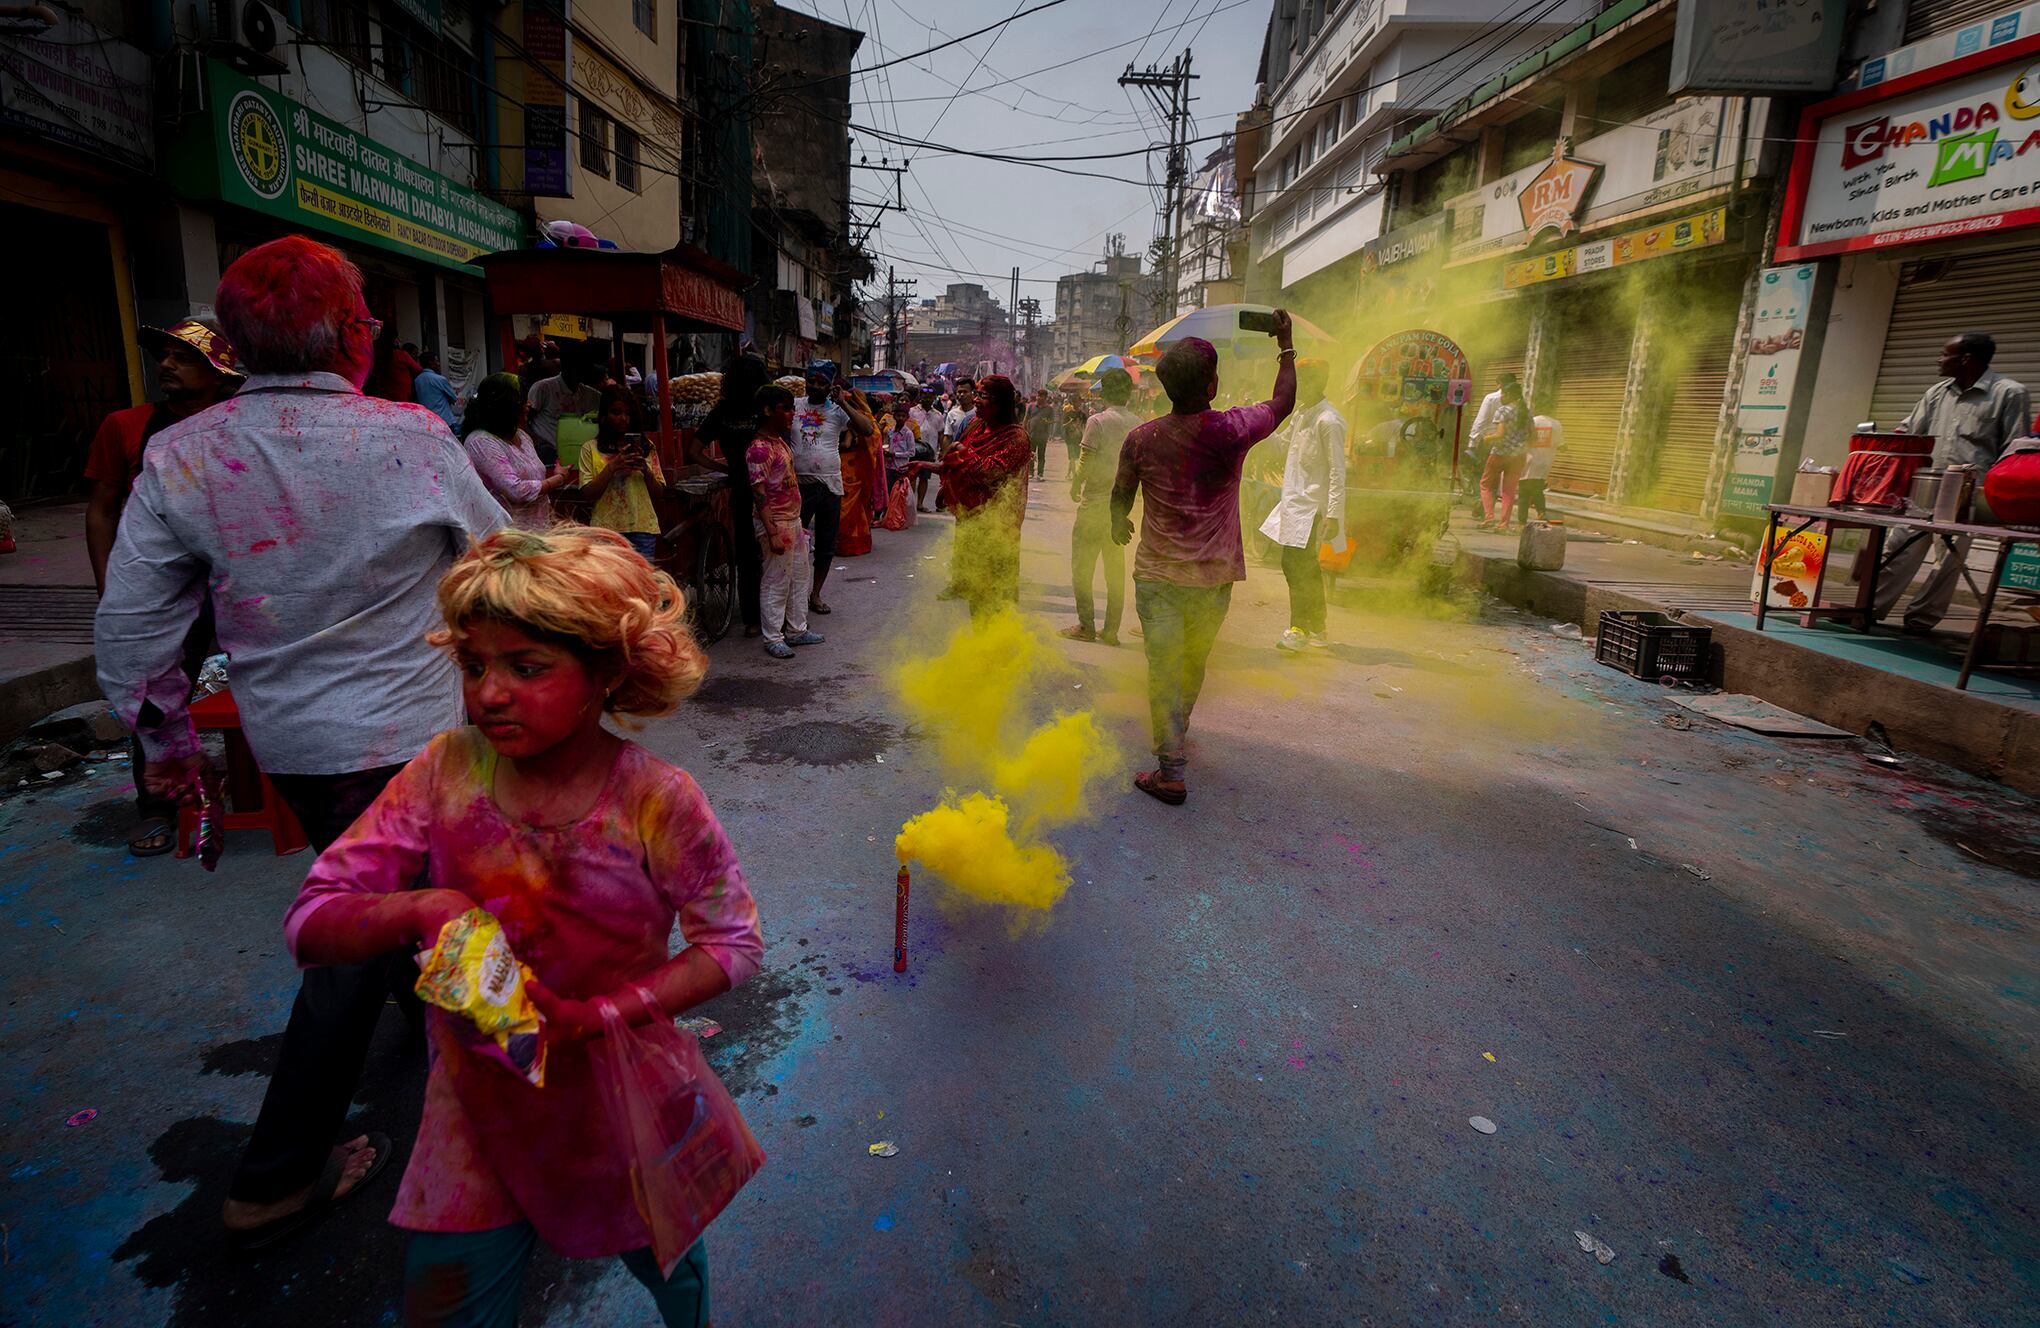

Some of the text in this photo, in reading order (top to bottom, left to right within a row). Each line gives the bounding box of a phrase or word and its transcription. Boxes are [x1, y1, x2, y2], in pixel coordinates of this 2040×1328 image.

[75, 81, 101, 108] HINDI
[1853, 102, 1999, 157] CHANDA
[293, 108, 435, 196] श्री मारवाड़ी दातव्य औषधालय
[1842, 162, 1897, 190] With You
[1848, 169, 1920, 202] Since Birth
[295, 143, 347, 189] SHREE
[350, 167, 409, 214] MARWARI
[411, 195, 456, 233] DATABYA
[457, 215, 518, 250] AUSHADHALAYA
[1532, 170, 1575, 213] RM
[1810, 216, 1869, 235] Newborn,
[1871, 206, 1900, 224] Kids
[1904, 201, 1931, 218] and
[1932, 192, 1987, 213] Mother
[1989, 184, 2029, 202] Care
[397, 223, 412, 241] FANCY
[1378, 229, 1439, 266] VAIBHAVAM
[1583, 255, 1606, 267] STORES
[1584, 245, 1605, 256] PRADIP
[1379, 332, 1460, 358] ANUPAM ICE GOLA
[1731, 477, 1765, 488] CHANDA
[1733, 487, 1759, 497] MAMA
